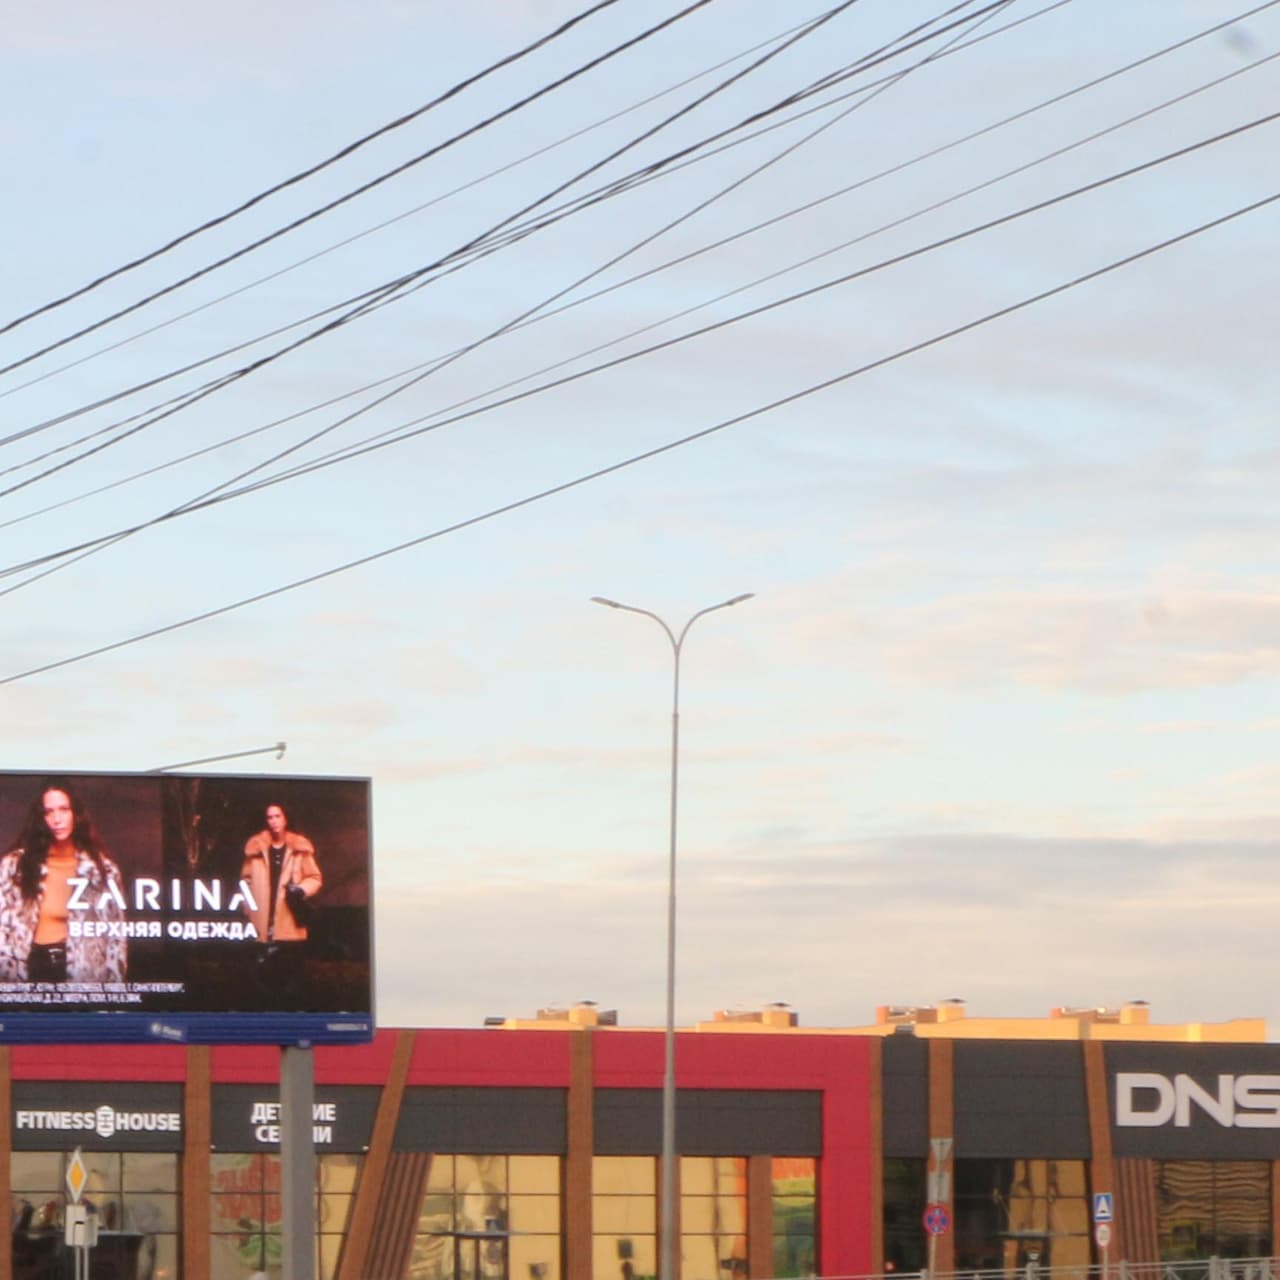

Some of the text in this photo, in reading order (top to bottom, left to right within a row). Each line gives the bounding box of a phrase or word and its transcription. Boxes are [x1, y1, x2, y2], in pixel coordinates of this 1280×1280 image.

[66, 877, 259, 912] ZARINA
[69, 921, 259, 940] ВЕРХНЯЯ ОДЕЖДА
[1116, 1072, 1280, 1128] DNS
[16, 1110, 181, 1132] FITNESS HOUSE
[250, 1103, 337, 1124] ДЕТИЕ
